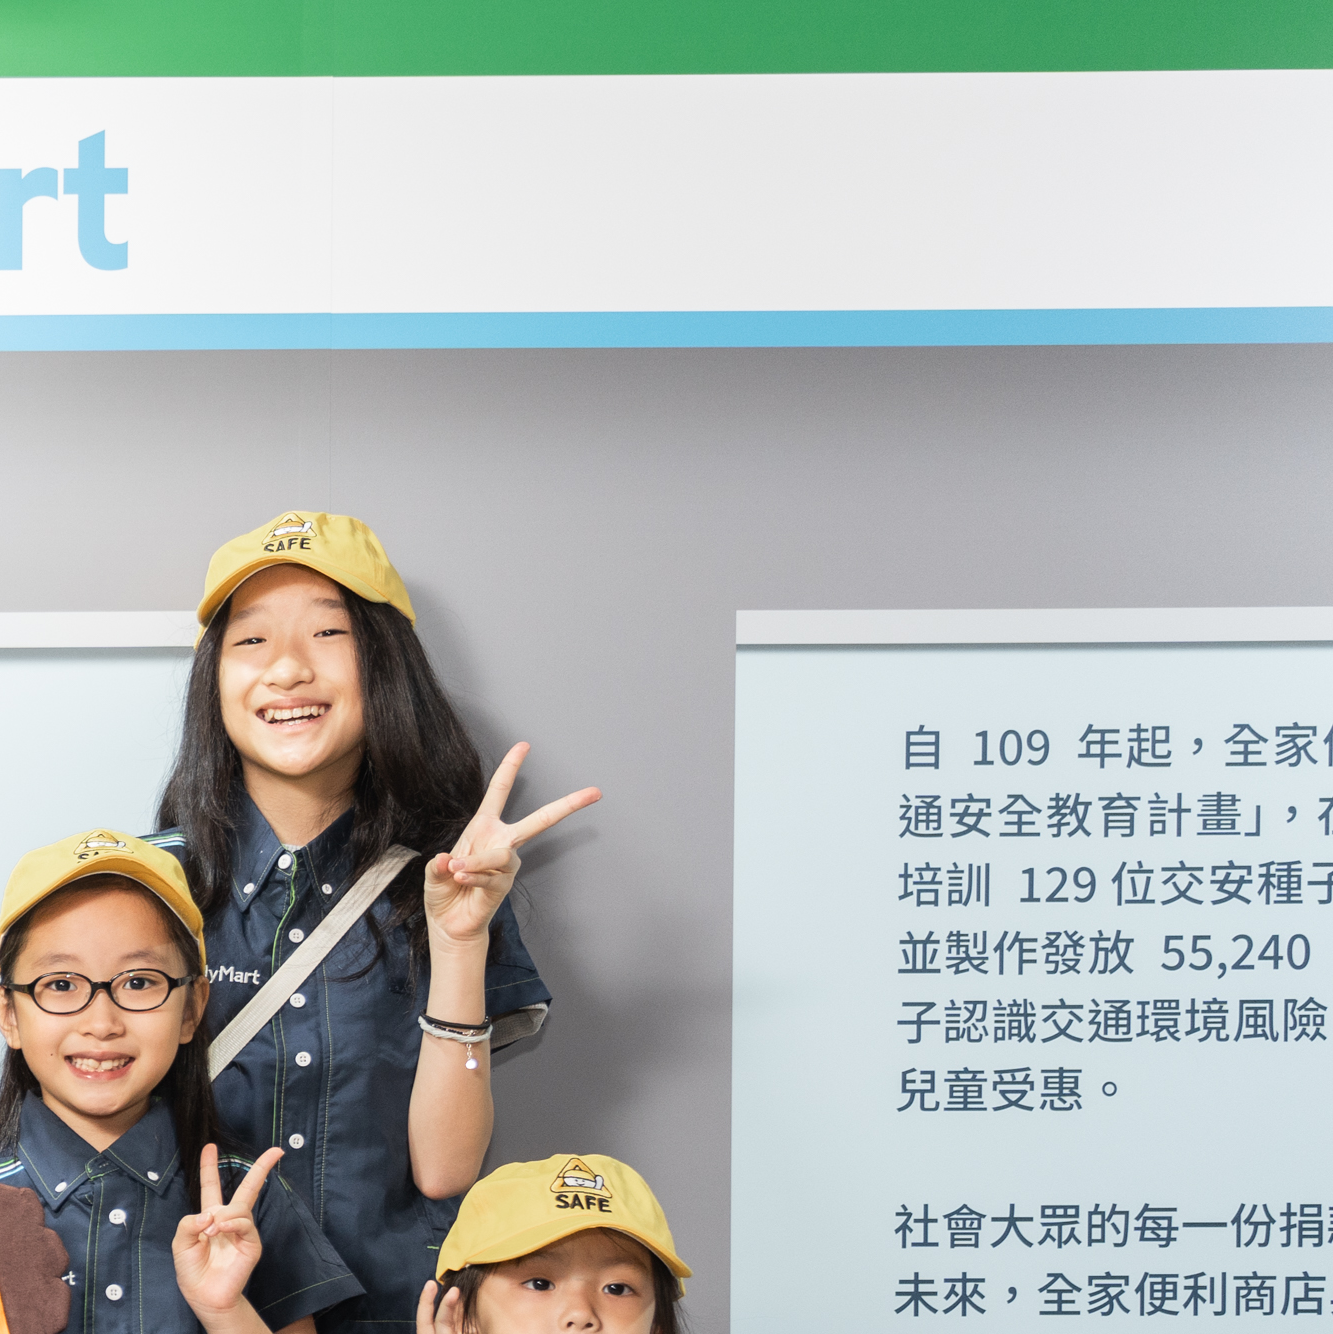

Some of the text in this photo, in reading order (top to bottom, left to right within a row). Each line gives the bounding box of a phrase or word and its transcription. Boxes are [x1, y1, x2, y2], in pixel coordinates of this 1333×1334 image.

[905, 721, 1333, 770] 自 109 年起，全家
[898, 861, 990, 907] 培訓
[897, 929, 1311, 980] 並製作發放 55,240
[896, 997, 1328, 1044] 子認識交通環境風險
[896, 1066, 1119, 1113] 兒童受惠。
[555, 1194, 613, 1213] SAFE
[894, 1202, 1333, 1249] 社會大眾的每一份捐
[894, 1271, 1333, 1317] 未來，全家便利商店
